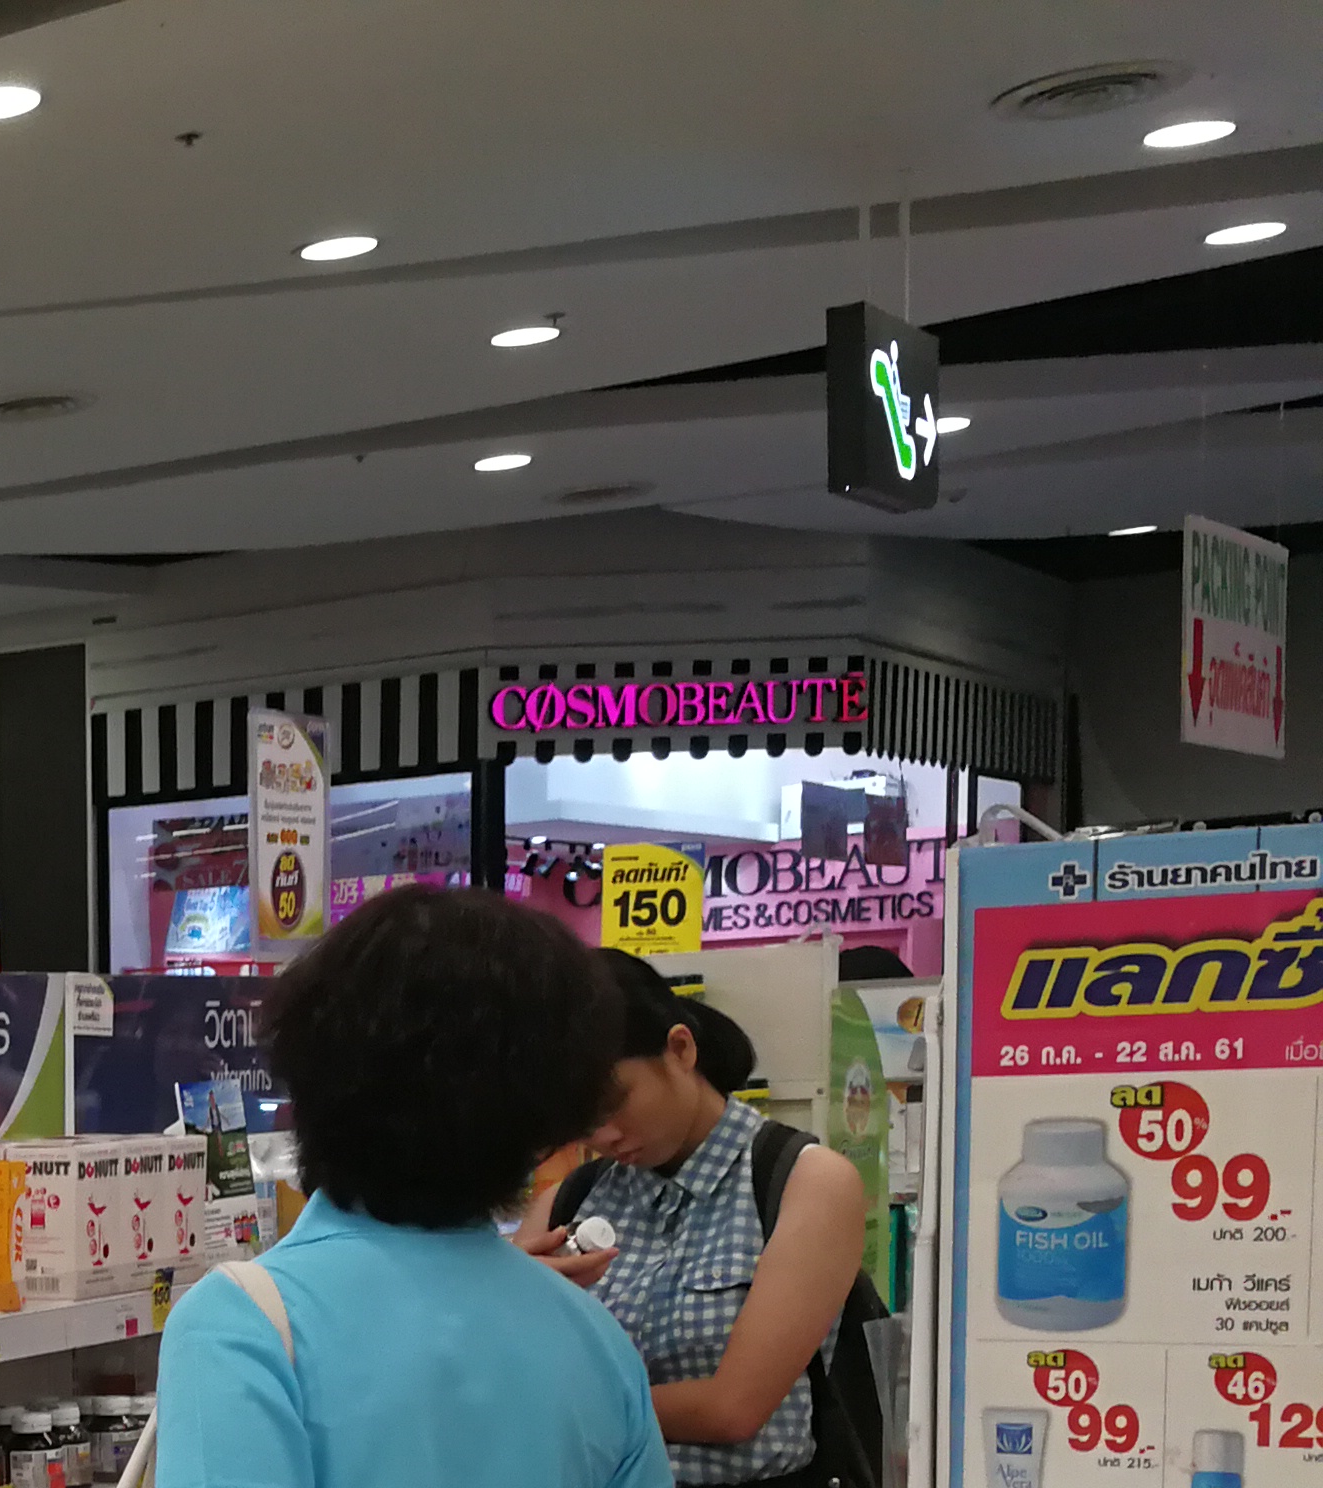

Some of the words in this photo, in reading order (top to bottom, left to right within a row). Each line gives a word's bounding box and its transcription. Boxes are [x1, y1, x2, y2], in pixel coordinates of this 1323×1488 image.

[1106, 853, 1318, 891] ร้านยาคนไทย
[613, 889, 687, 929] 150
[999, 1046, 1029, 1066] 26
[1115, 1042, 1147, 1063] 22
[1214, 1038, 1244, 1060] 61
[1111, 1084, 1163, 1109] ลด
[1015, 1230, 1068, 1251] FISH
[1072, 1231, 1109, 1250] OIL
[1215, 1317, 1235, 1331] 30
